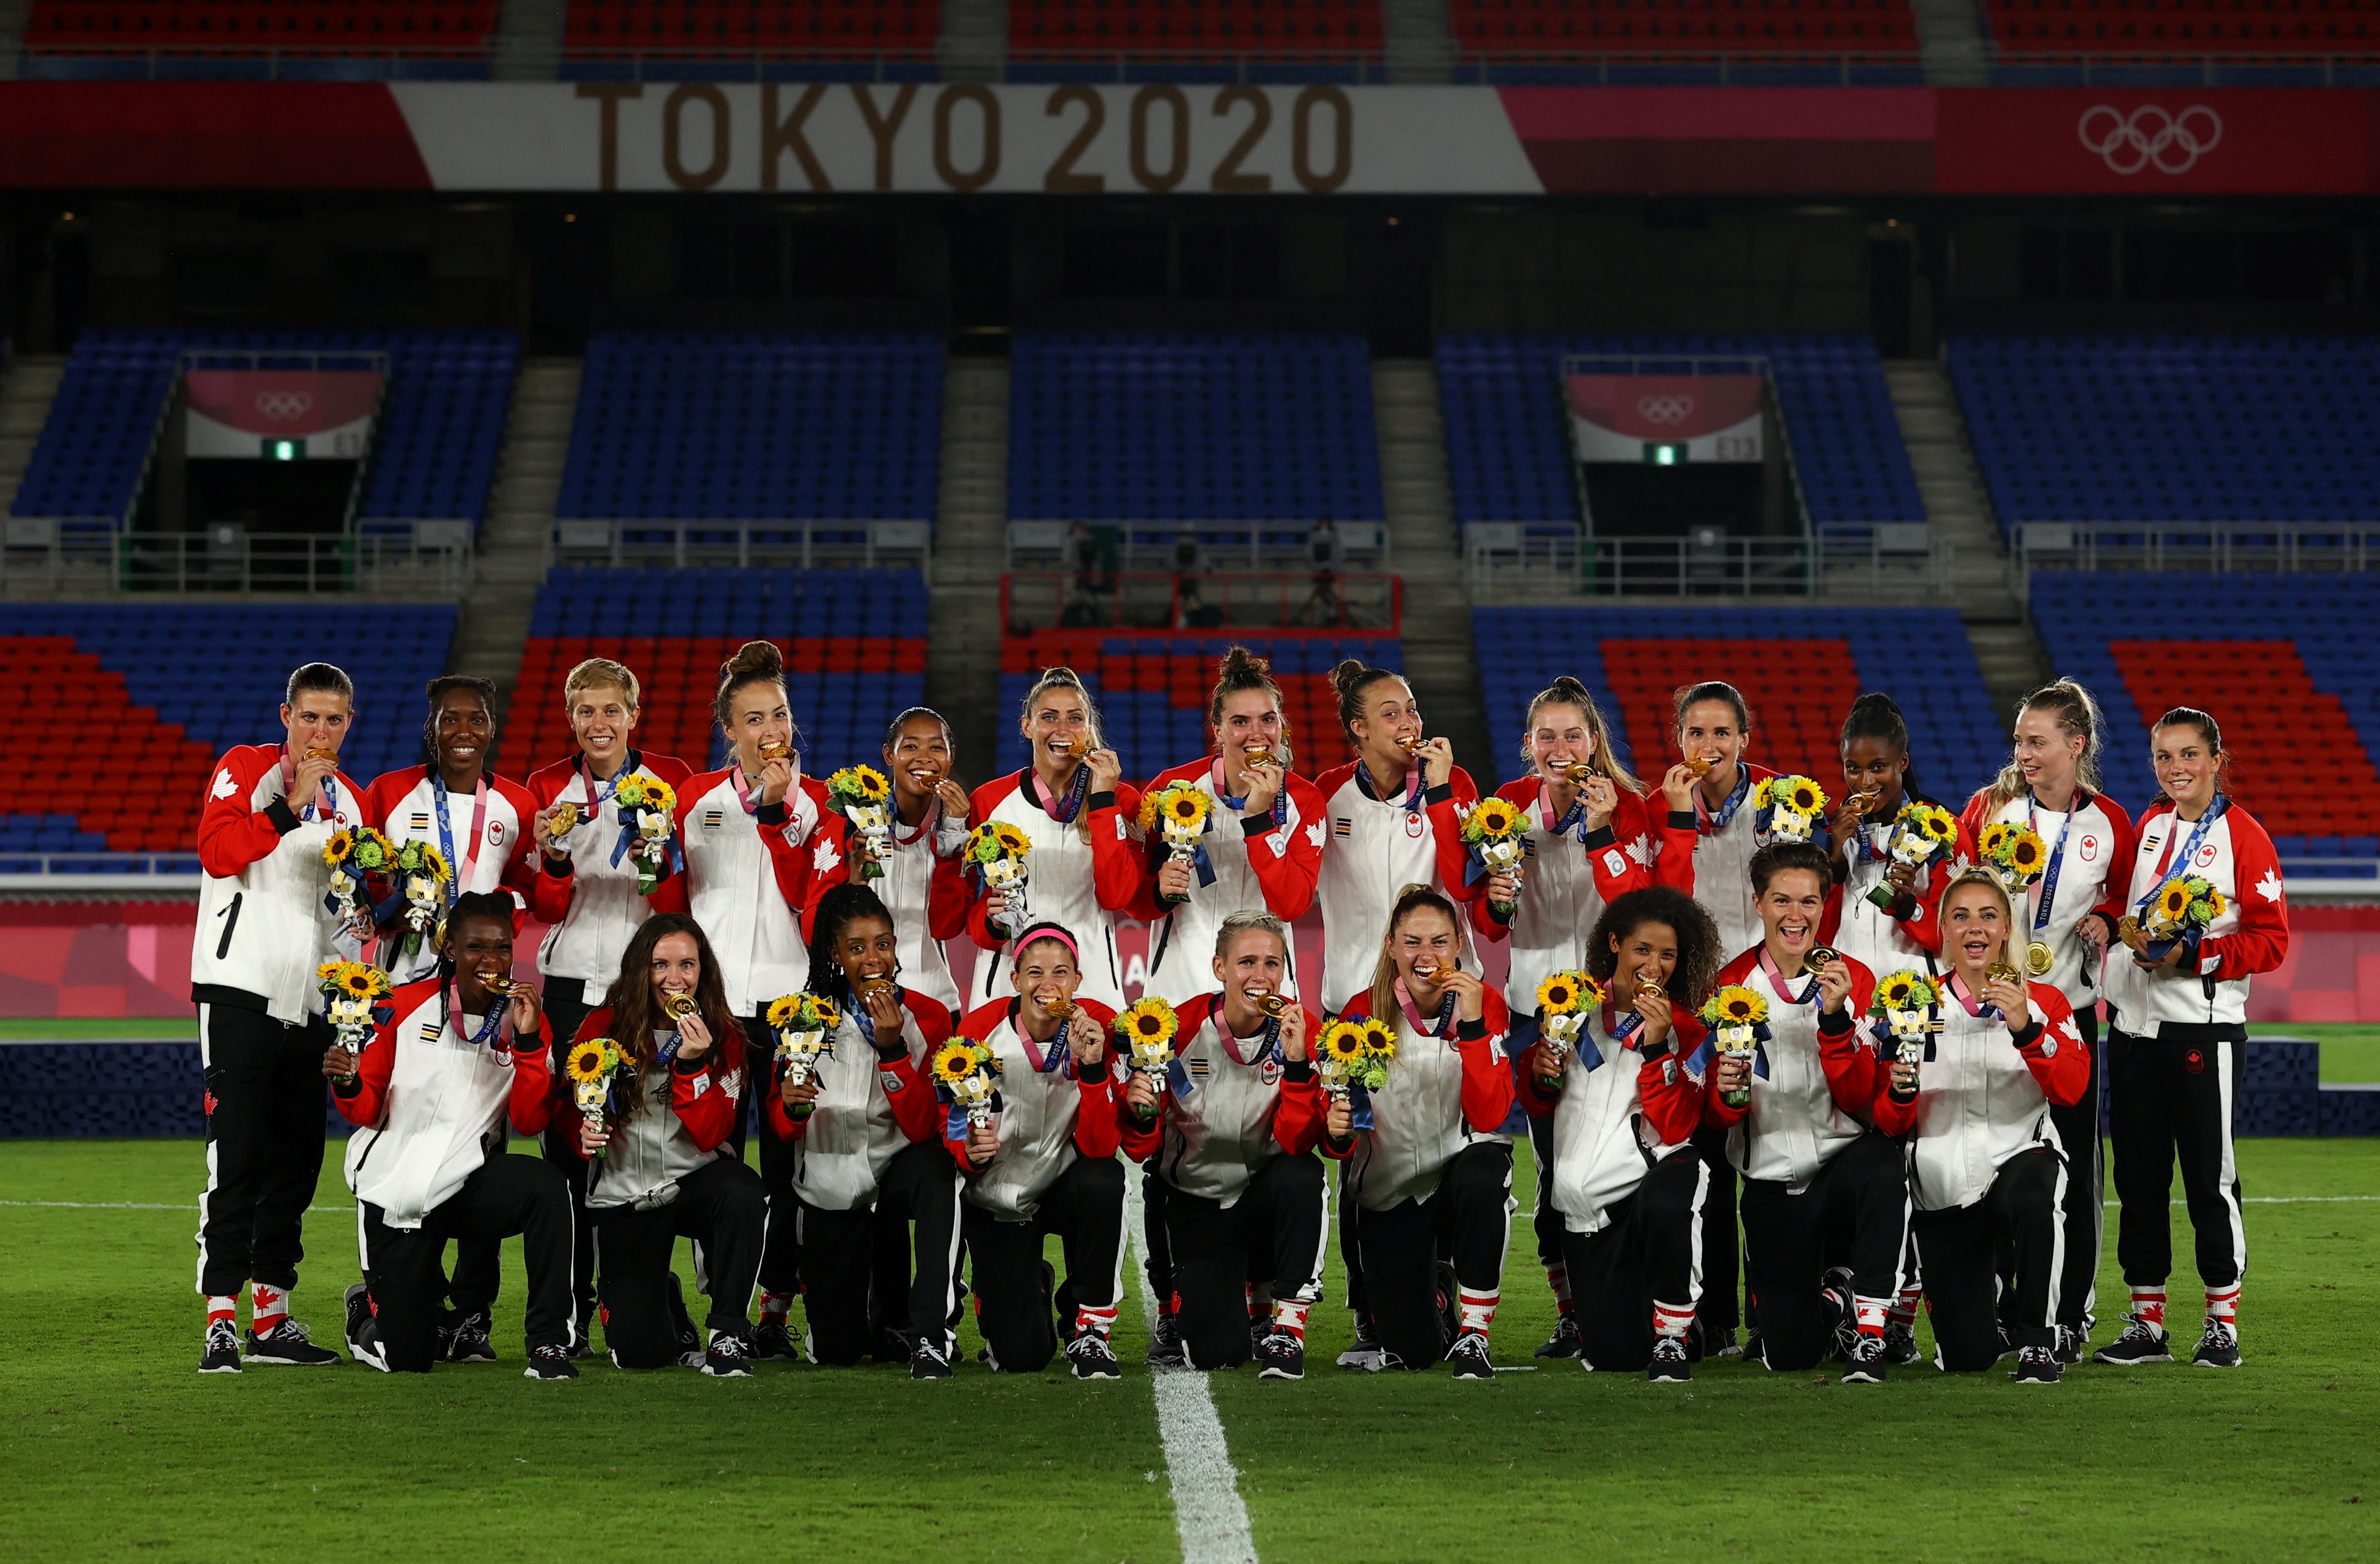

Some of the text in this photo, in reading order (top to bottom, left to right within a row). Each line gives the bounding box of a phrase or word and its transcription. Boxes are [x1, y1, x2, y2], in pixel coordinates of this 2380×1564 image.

[576, 82, 1353, 193] TOKYO 2020
[1074, 768, 1088, 803] TOKYO 2020
[1416, 782, 1425, 796] 2020
[1567, 806, 1579, 820] 2020
[2144, 890, 2161, 902] TOKYO
[2039, 900, 2049, 921] TOKYO
[1803, 987, 1815, 1000] 2020
[484, 999, 505, 1033] TOKYO 2020
[1439, 992, 1453, 1029] TOKYO 2020
[1623, 1016, 1637, 1031] 2020
[664, 1041, 676, 1056] 2020
[1051, 1023, 1069, 1060] TOKYO 2020
[1260, 1021, 1281, 1056] TOKYO 2020
